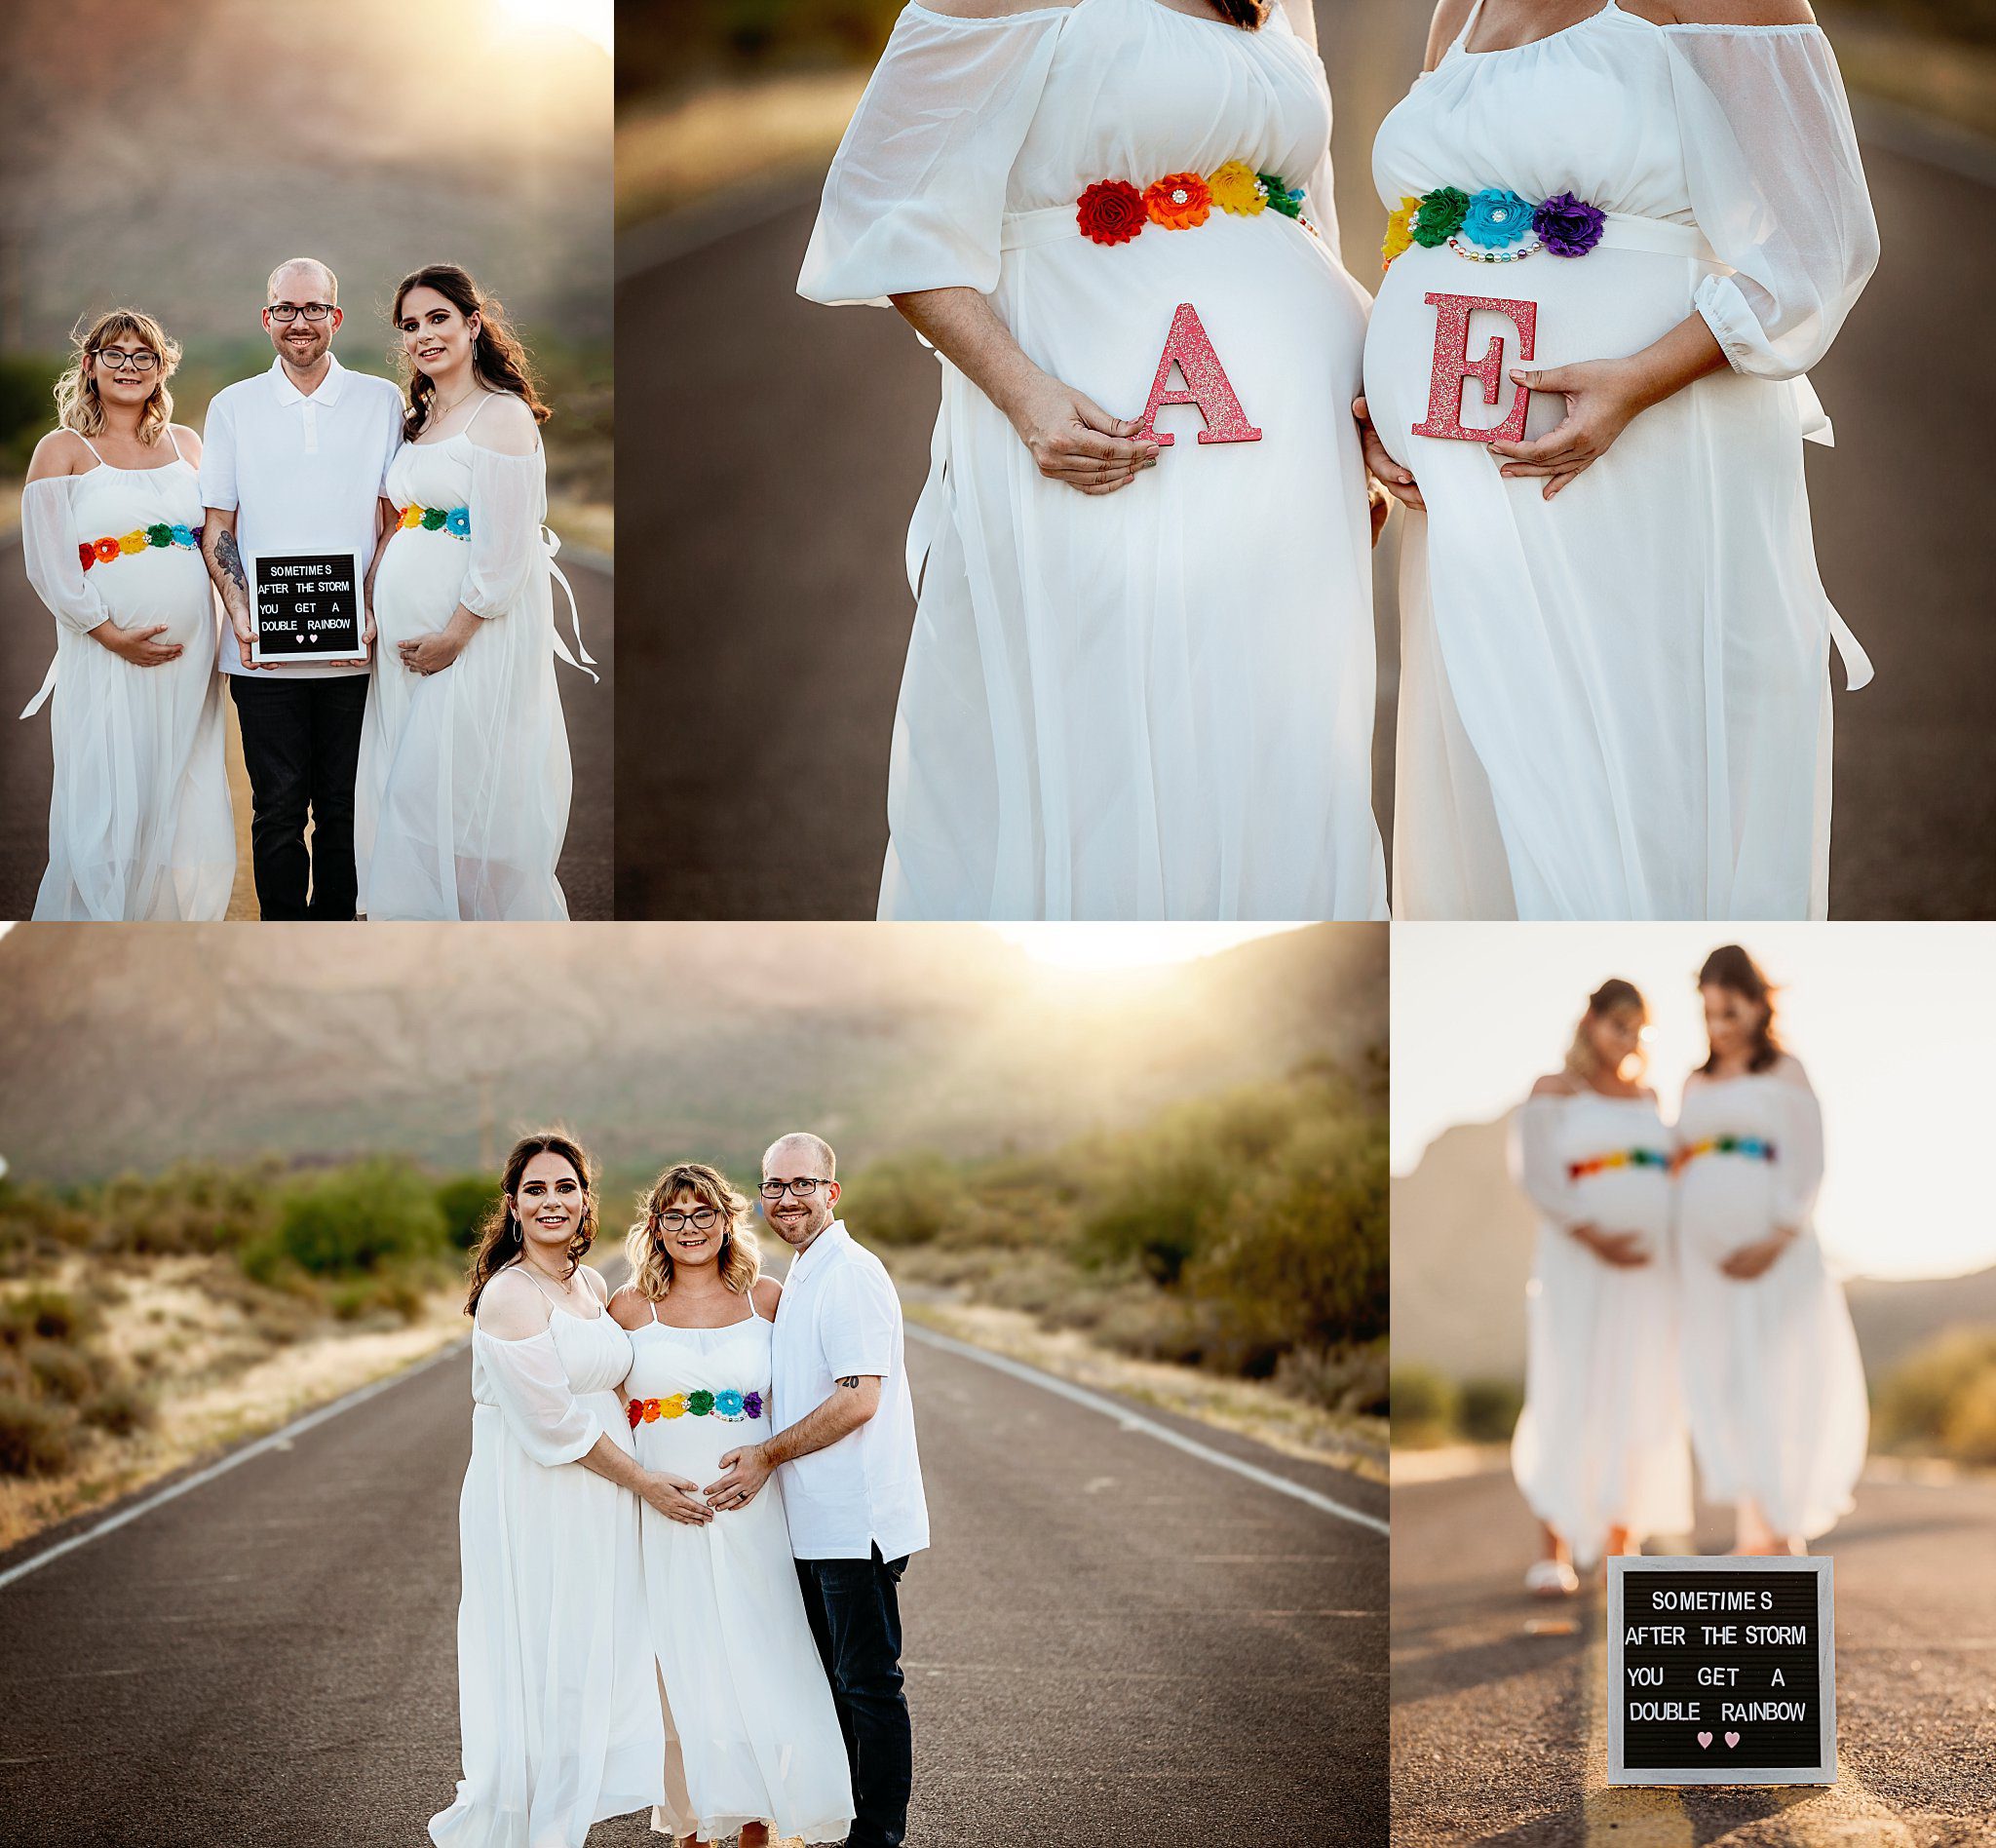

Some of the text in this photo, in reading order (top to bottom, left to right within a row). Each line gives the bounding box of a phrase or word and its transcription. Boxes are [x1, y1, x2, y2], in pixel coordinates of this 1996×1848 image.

[1128, 302, 1262, 446] A
[1411, 291, 1537, 443] E
[270, 564, 332, 577] SOMETIMES
[257, 581, 350, 595] AFTER THE STORM
[259, 602, 339, 615] YOU GET A
[261, 619, 351, 632] DOUBLE RAINBOW
[1652, 1591, 1773, 1611] SOMETIMES
[1625, 1625, 1806, 1646] AFTER THE STORM
[1627, 1667, 1785, 1687] YOU GET A
[1630, 1702, 1806, 1722] DOUBLE RAINBOW
